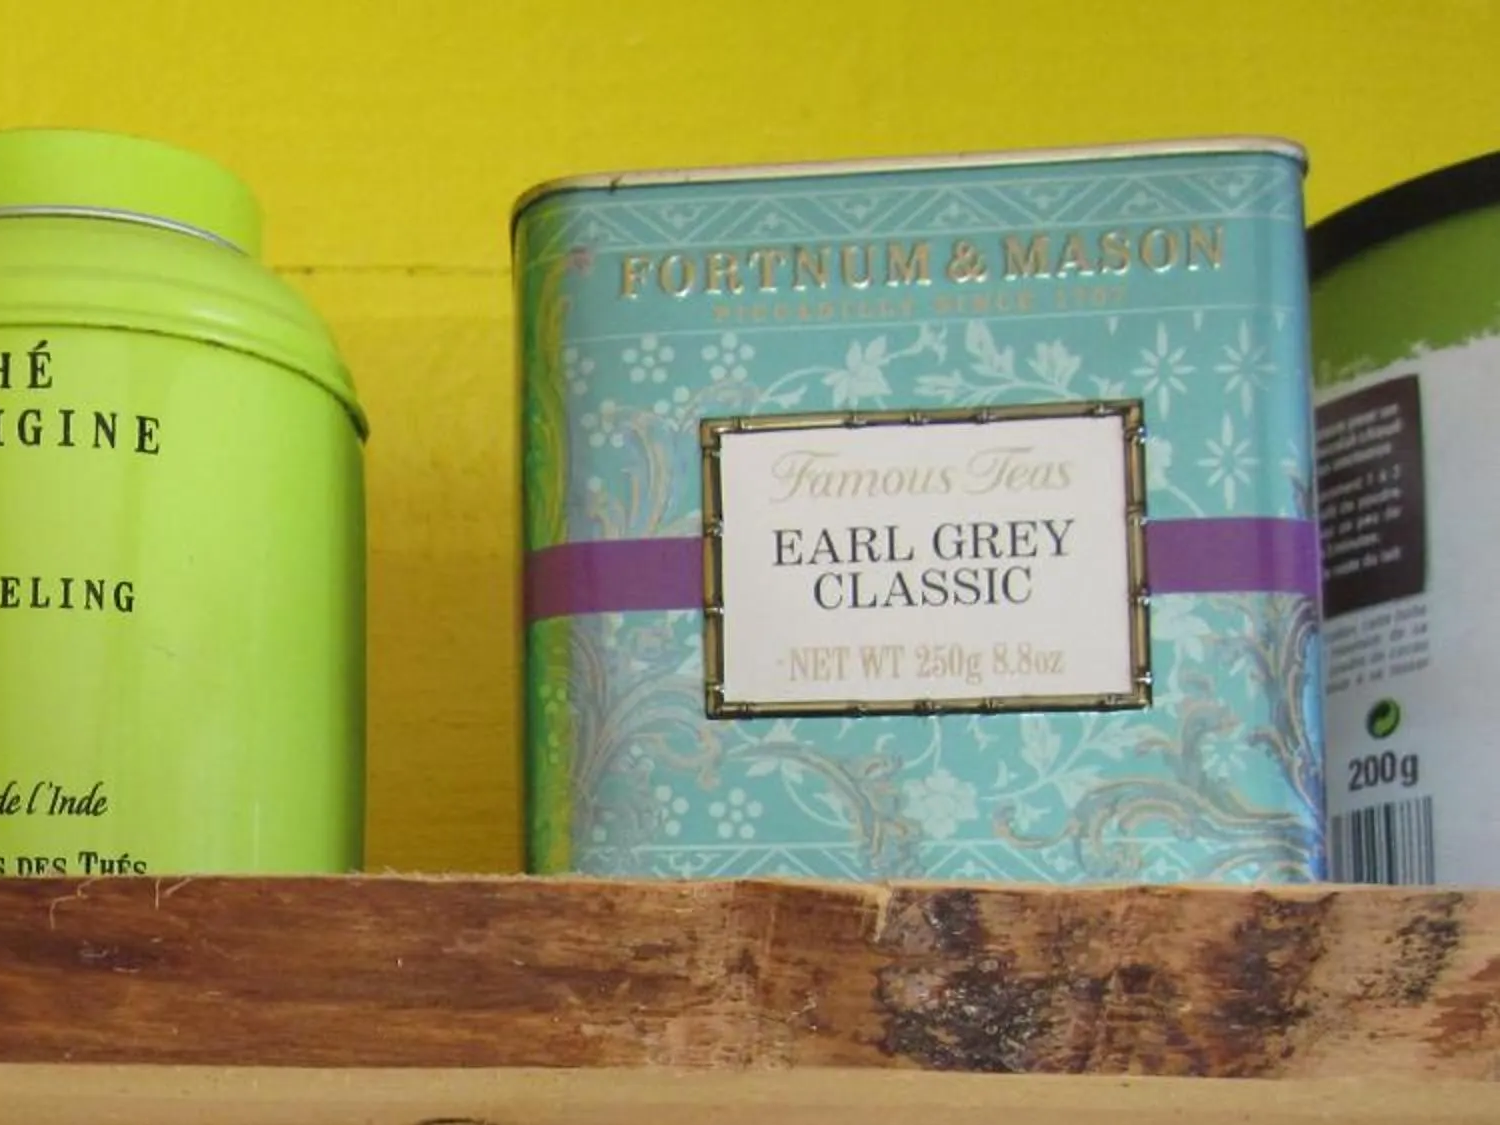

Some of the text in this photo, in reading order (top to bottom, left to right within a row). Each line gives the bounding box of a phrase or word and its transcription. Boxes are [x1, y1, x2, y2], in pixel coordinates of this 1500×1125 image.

[620, 224, 1225, 302] FORTNUM & MASON
[769, 446, 1074, 503] Famous Teas
[772, 519, 1075, 566] EARL GREY
[813, 566, 1032, 610] CLASSIC
[789, 643, 1065, 684] NET WT 250g 8.8oz
